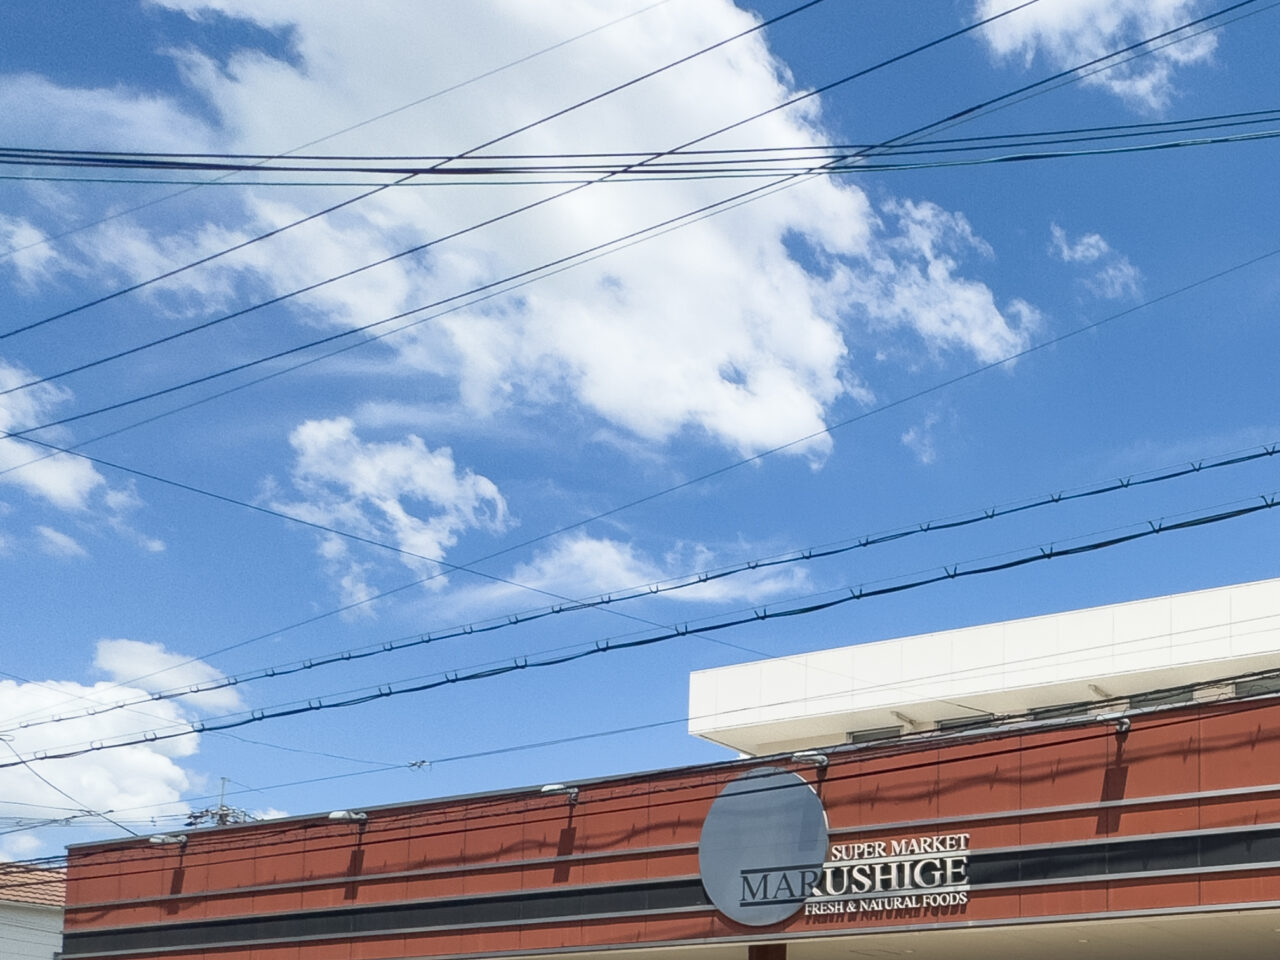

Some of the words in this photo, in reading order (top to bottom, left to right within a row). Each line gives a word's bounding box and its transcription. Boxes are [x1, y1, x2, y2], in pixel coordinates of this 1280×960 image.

[831, 840, 886, 861] SUPER
[890, 833, 970, 856] MARKET
[740, 856, 969, 901] MARUSHIGE
[804, 901, 844, 915] FRESH
[846, 902, 857, 913] &
[859, 895, 921, 911] NATURAL
[922, 892, 968, 906] FOODS
